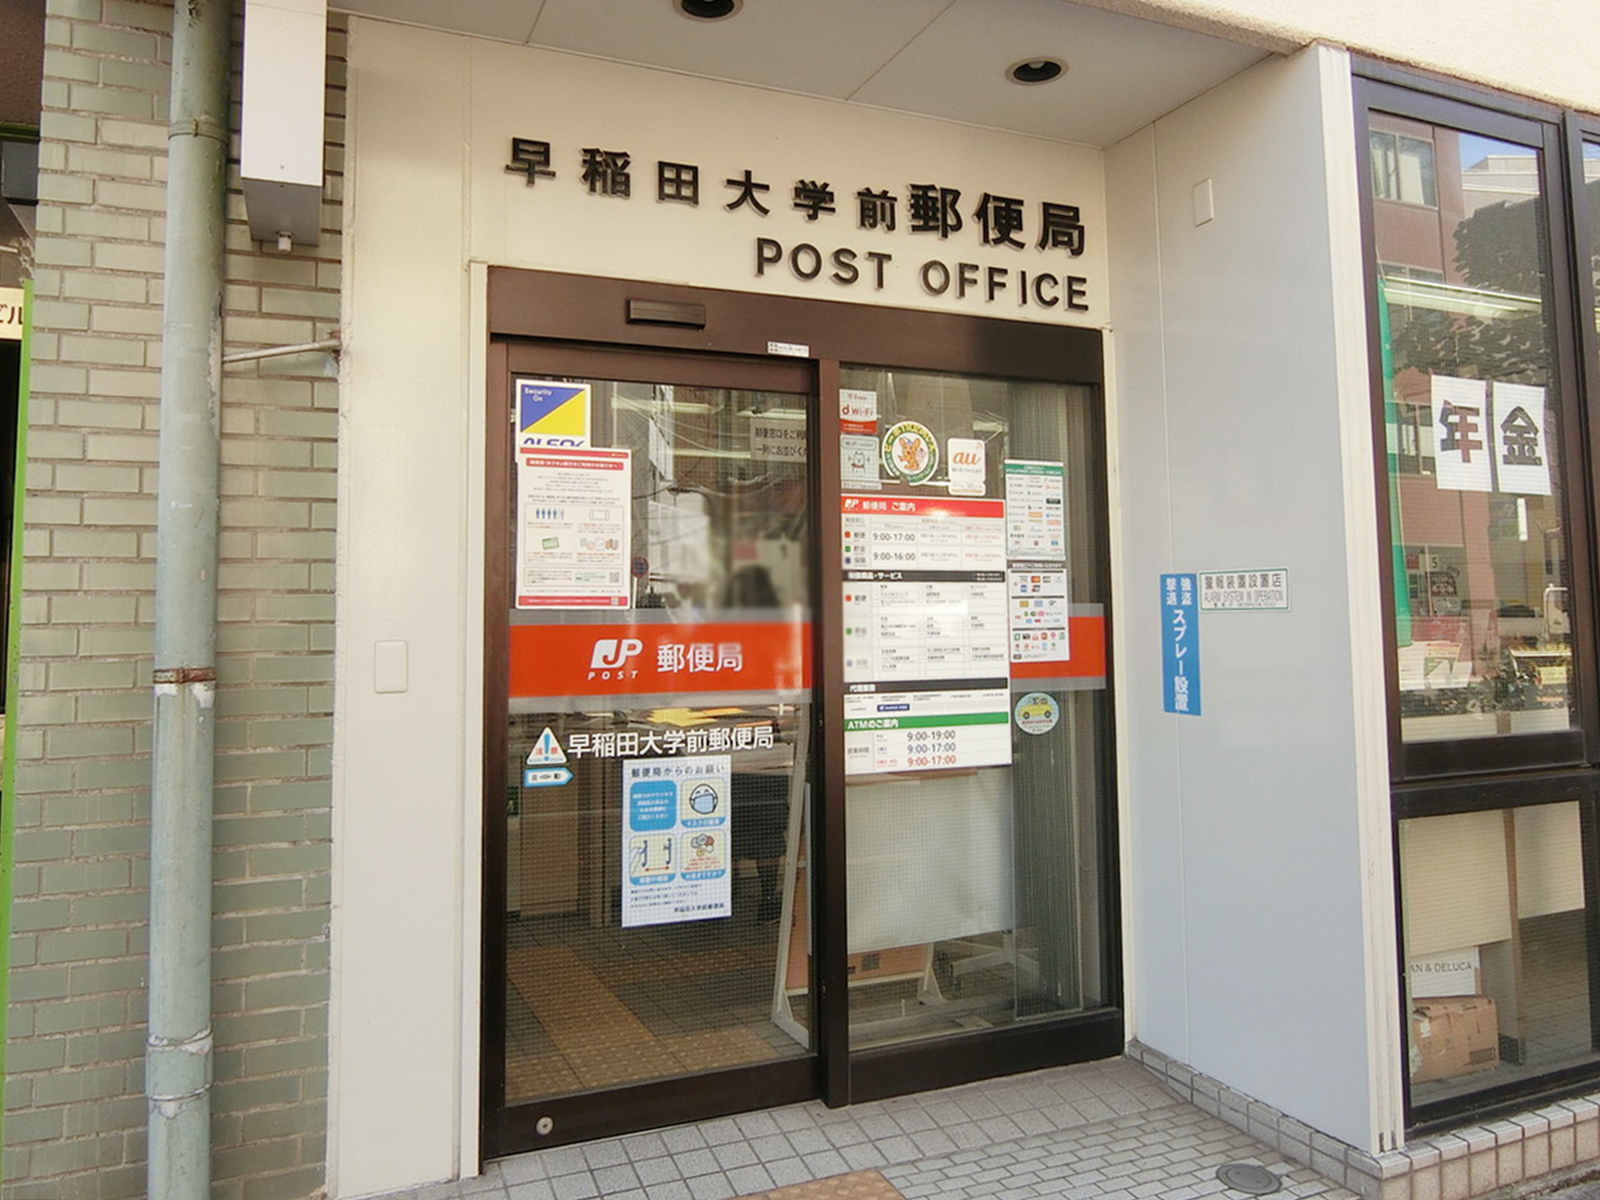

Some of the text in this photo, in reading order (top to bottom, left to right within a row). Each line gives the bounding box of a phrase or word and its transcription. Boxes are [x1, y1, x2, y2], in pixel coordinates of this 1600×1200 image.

[505, 137, 1086, 257] 早稲田大学前郵便局
[756, 237, 1089, 311] POST OFFICE
[525, 387, 552, 396] Security
[755, 427, 806, 440] 郵便窓口をご利
[953, 451, 981, 465] au
[862, 501, 887, 511] 郵便局
[891, 502, 916, 512] ご案内
[873, 533, 915, 542] 9:00-17:00
[873, 552, 915, 561] 9:00-16:00
[590, 639, 643, 669] JP
[656, 642, 743, 673] 郵便局
[1172, 609, 1189, 711] スプレー設置
[587, 670, 639, 680] POST
[847, 718, 899, 730] ATMのご案内
[907, 730, 956, 741] 9:00-19:00
[567, 726, 774, 758] 早稲田大学前郵便局
[907, 742, 956, 754] 9:00-17:00
[907, 755, 957, 767] 9:00-17:00
[631, 765, 725, 778] 郵便局からのお願い
[1434, 962, 1472, 973] DELUCA
